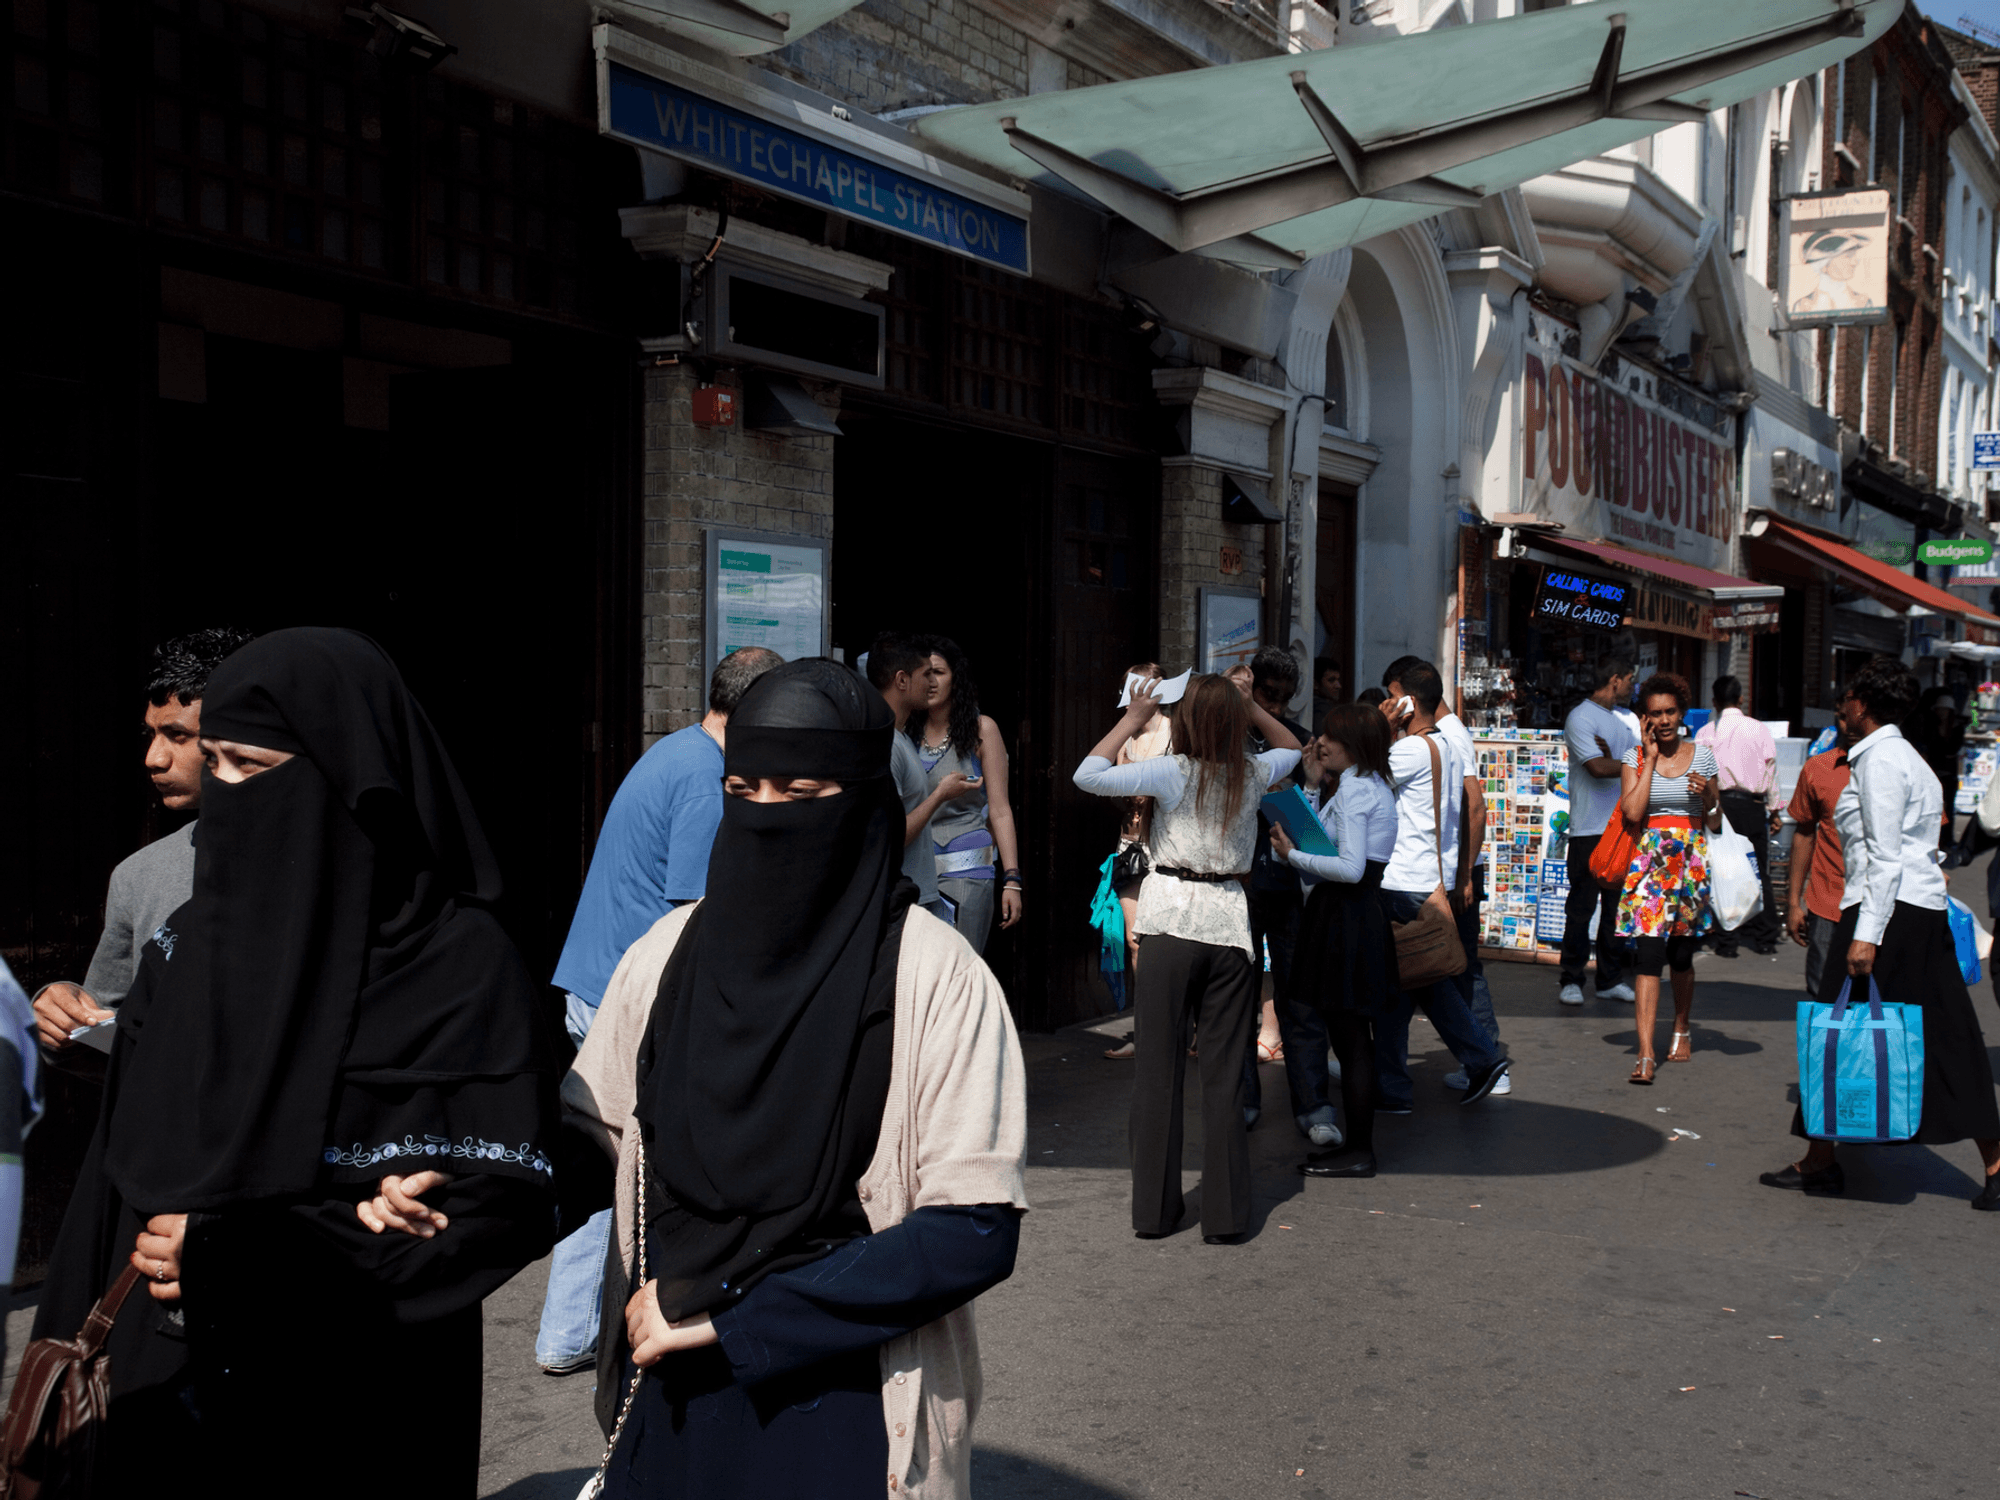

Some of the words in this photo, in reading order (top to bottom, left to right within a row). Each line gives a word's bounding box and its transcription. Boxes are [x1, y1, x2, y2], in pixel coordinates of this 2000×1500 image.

[653, 92, 885, 213] WHITECHAPEL
[894, 183, 1000, 254] STATION
[1525, 352, 1734, 545] POUNDBUSTERS
[1222, 552, 1242, 569] RVP
[1925, 544, 1985, 560] Budgens
[1546, 572, 1589, 593] CALLING
[1591, 582, 1625, 602] CARDS
[1541, 598, 1569, 617] SIM
[1571, 602, 1620, 628] CARDS
